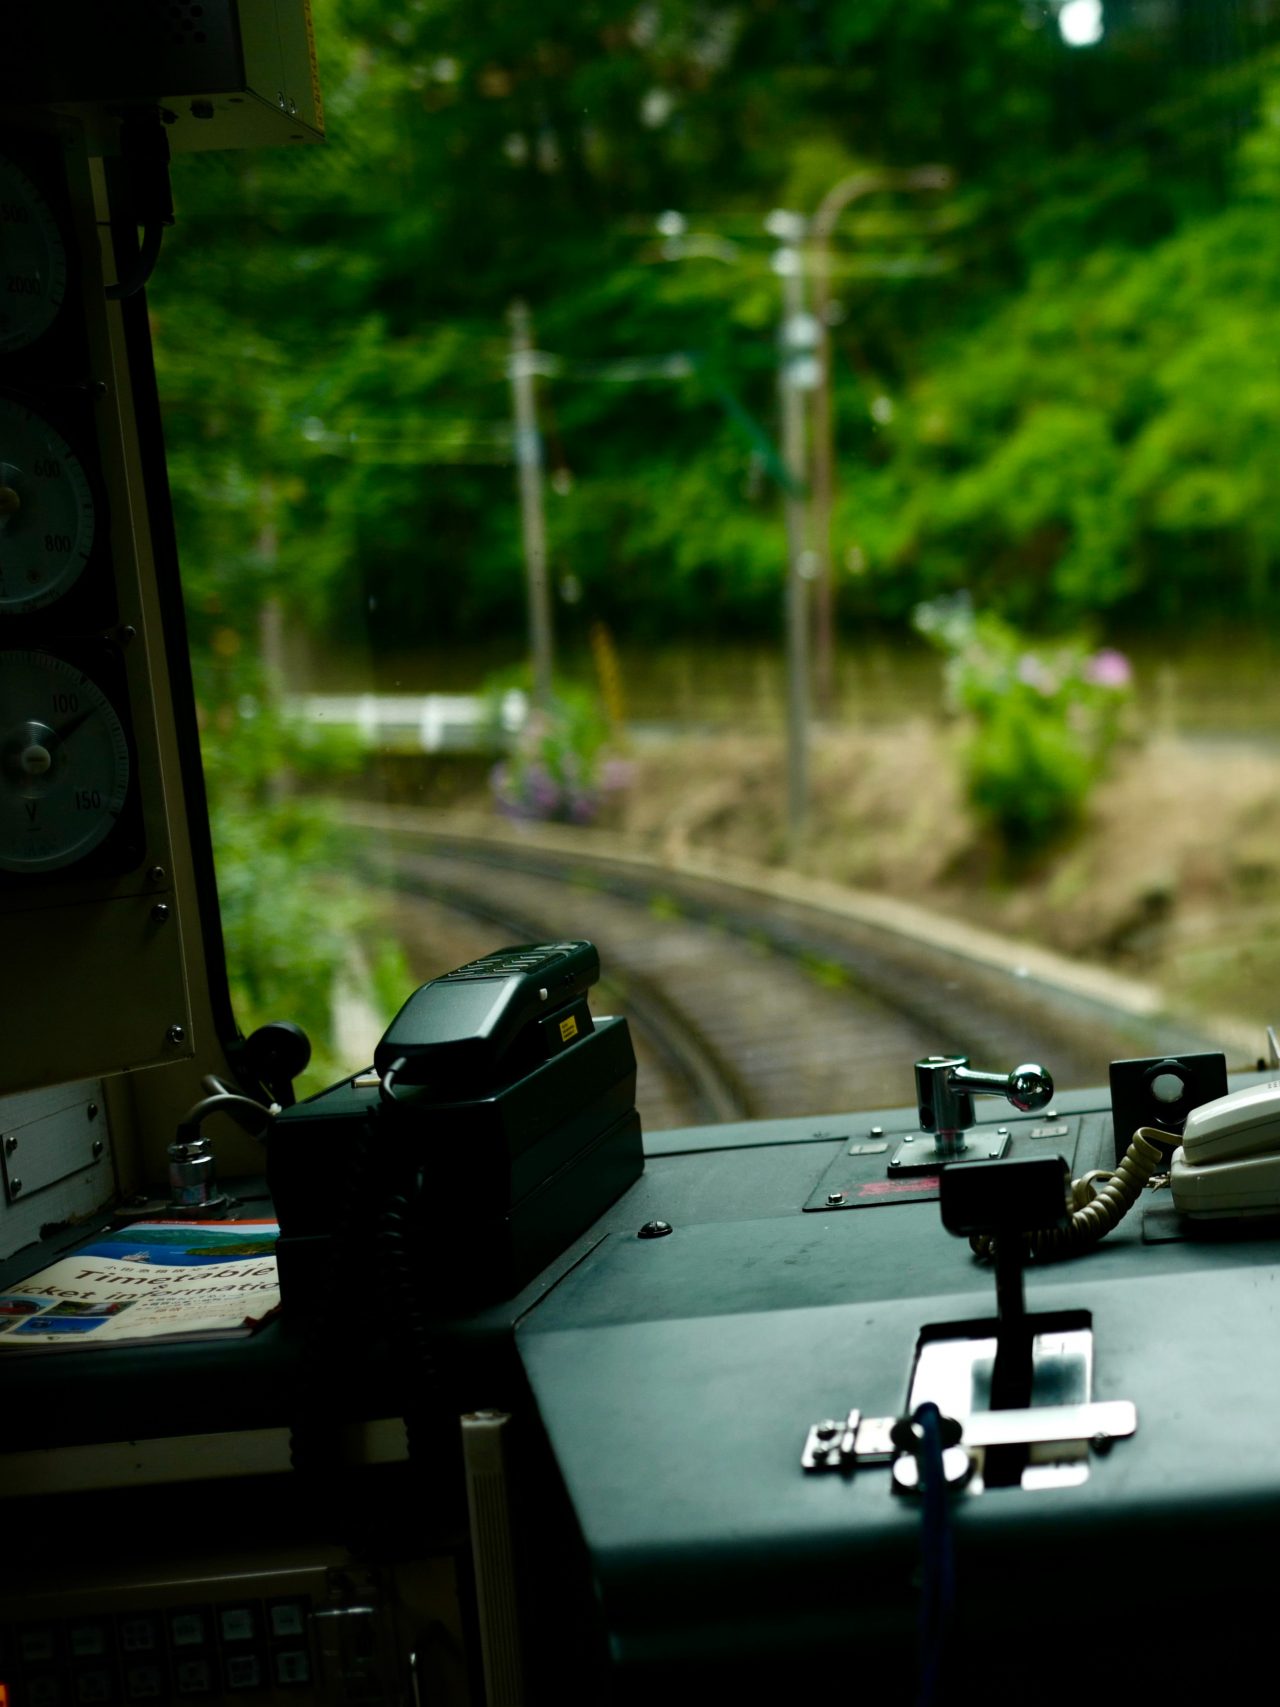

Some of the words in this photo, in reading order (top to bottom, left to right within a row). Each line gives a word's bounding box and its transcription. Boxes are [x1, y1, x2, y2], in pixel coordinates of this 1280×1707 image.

[7, 275, 40, 296] 2000
[34, 459, 61, 477] 600
[45, 534, 71, 552] 800
[52, 693, 78, 713] 100
[75, 790, 101, 810] 150
[25, 802, 38, 822] V
[75, 1265, 276, 1286] Timetable
[10, 1284, 97, 1300] icket
[104, 1281, 280, 1301] informatio
